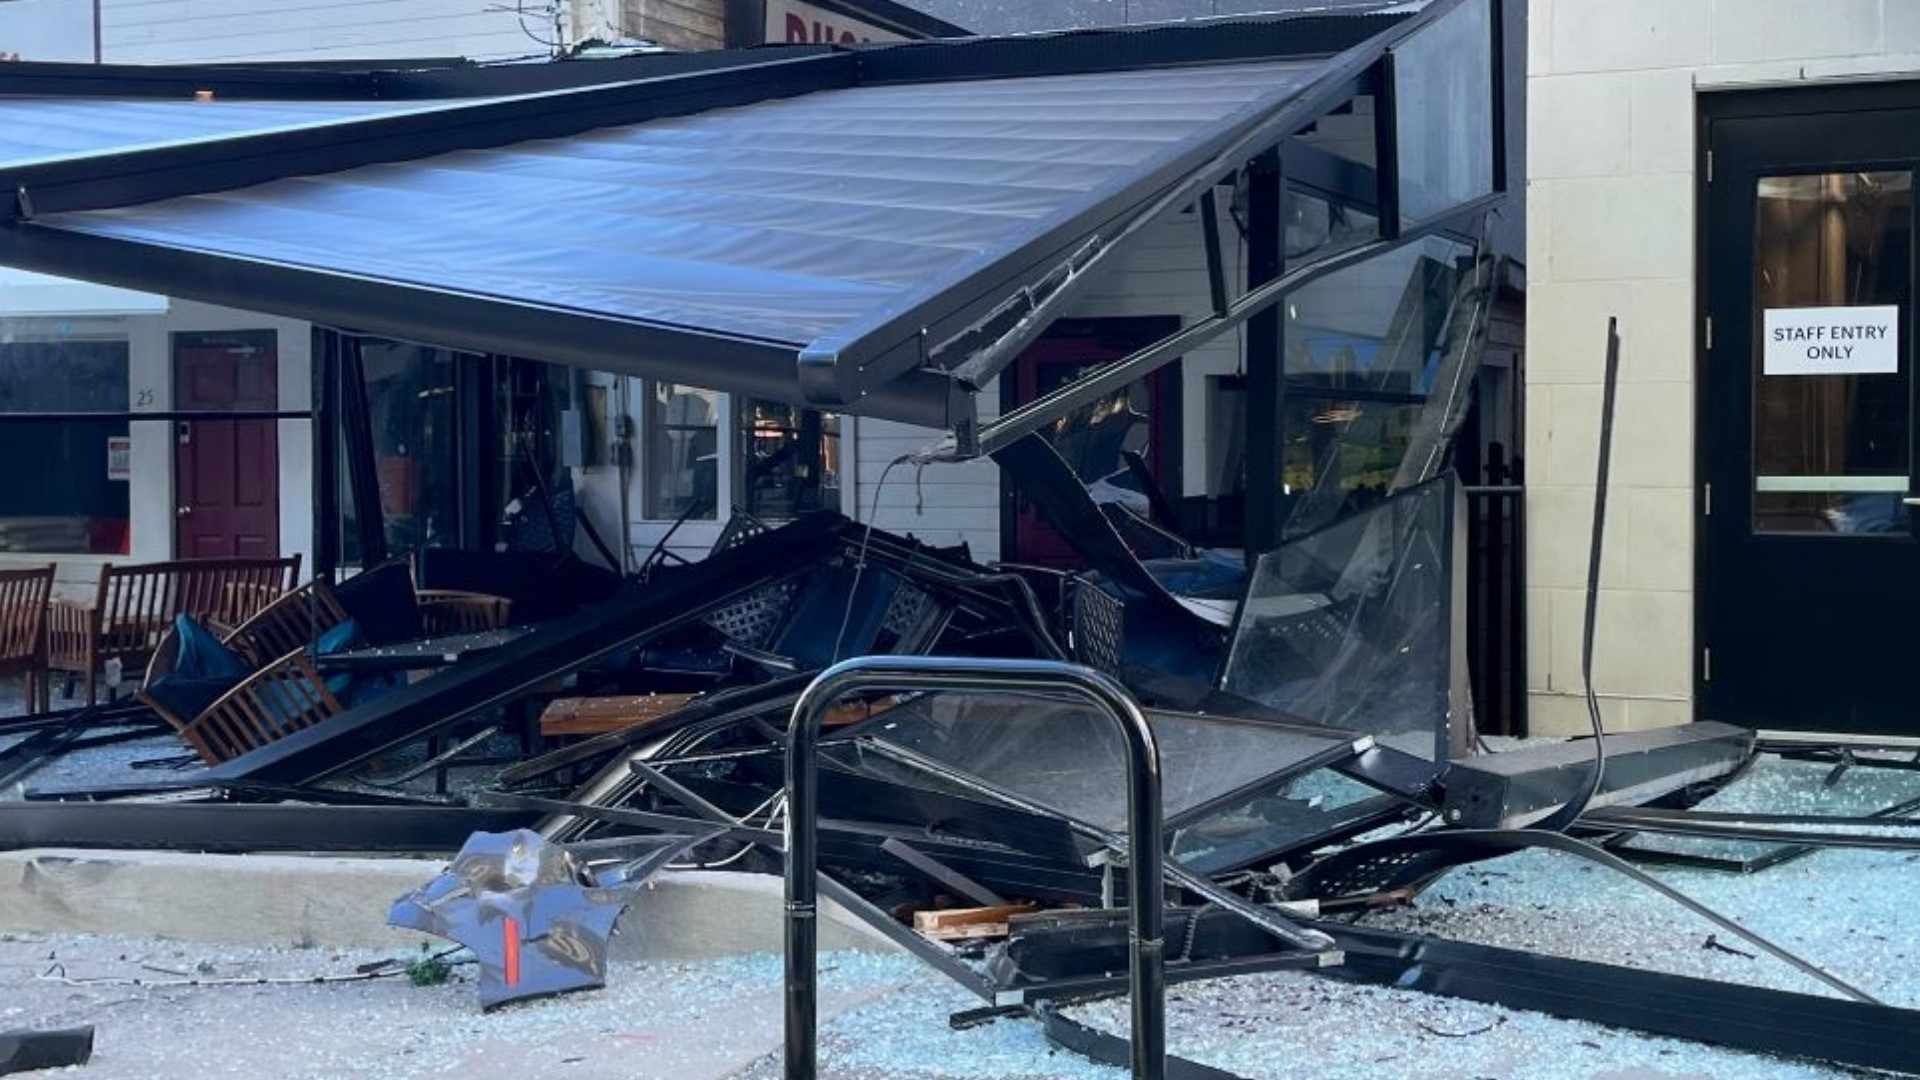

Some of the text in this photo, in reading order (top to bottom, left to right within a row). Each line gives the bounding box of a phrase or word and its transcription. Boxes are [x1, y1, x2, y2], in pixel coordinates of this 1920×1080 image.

[1773, 325, 1888, 341] STAFF ENTRY
[1807, 346, 1854, 359] ONLY
